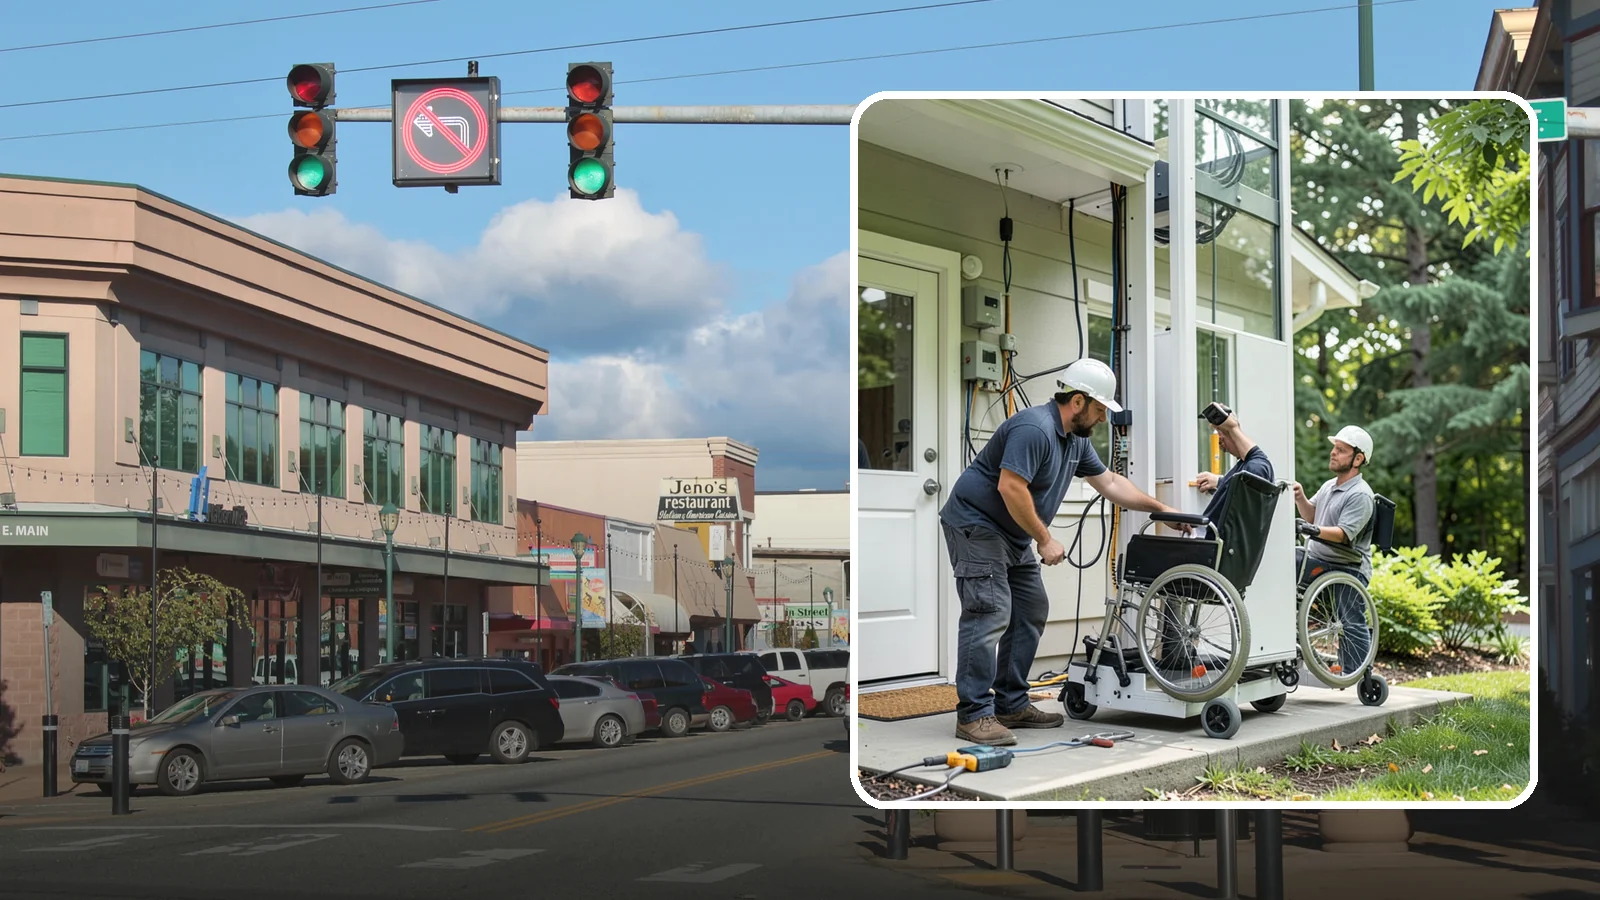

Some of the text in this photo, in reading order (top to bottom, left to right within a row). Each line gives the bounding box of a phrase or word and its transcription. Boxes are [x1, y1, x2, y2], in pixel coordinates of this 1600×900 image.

[670, 480, 728, 494] Jeno's
[665, 496, 731, 509] restaurant
[658, 510, 682, 519] Italian
[686, 510, 714, 519] American
[715, 509, 737, 519] Cuisine
[2, 525, 49, 536] E. MAIN
[797, 607, 828, 617] Street
[790, 619, 824, 627] lass
